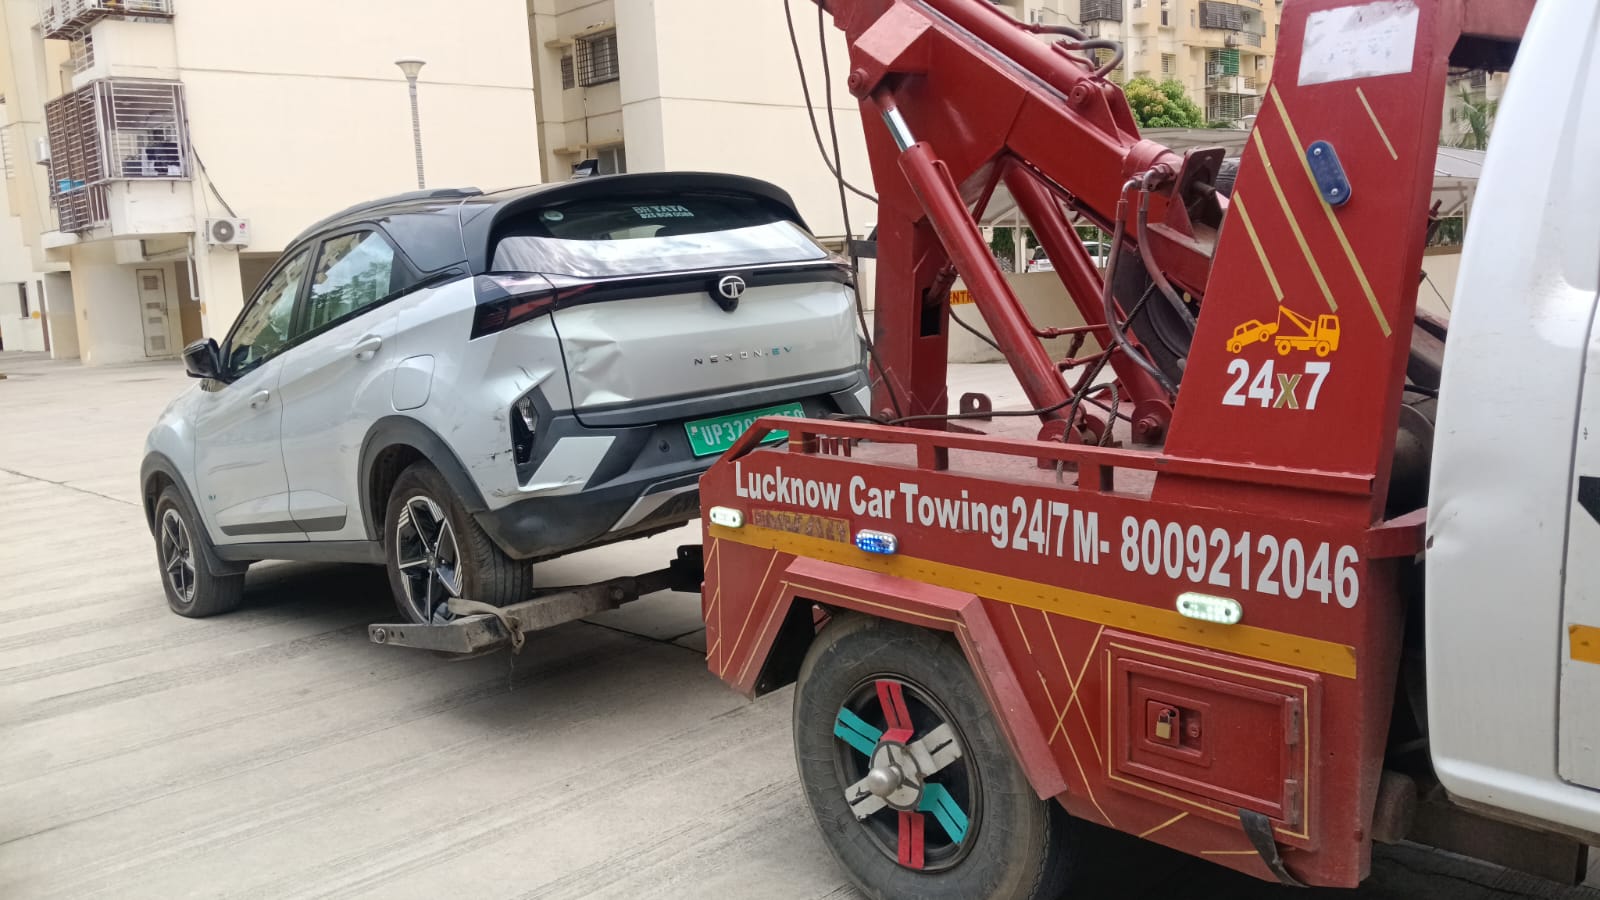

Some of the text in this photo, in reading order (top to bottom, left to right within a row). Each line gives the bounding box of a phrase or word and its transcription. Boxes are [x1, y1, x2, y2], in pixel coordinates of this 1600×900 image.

[1221, 358, 1331, 411] 24x7
[735, 461, 841, 511] Lucknow
[849, 475, 896, 519] Car
[899, 483, 1008, 549] Towing
[1012, 496, 1069, 557] 24/7
[1120, 516, 1360, 609] 8009212046
